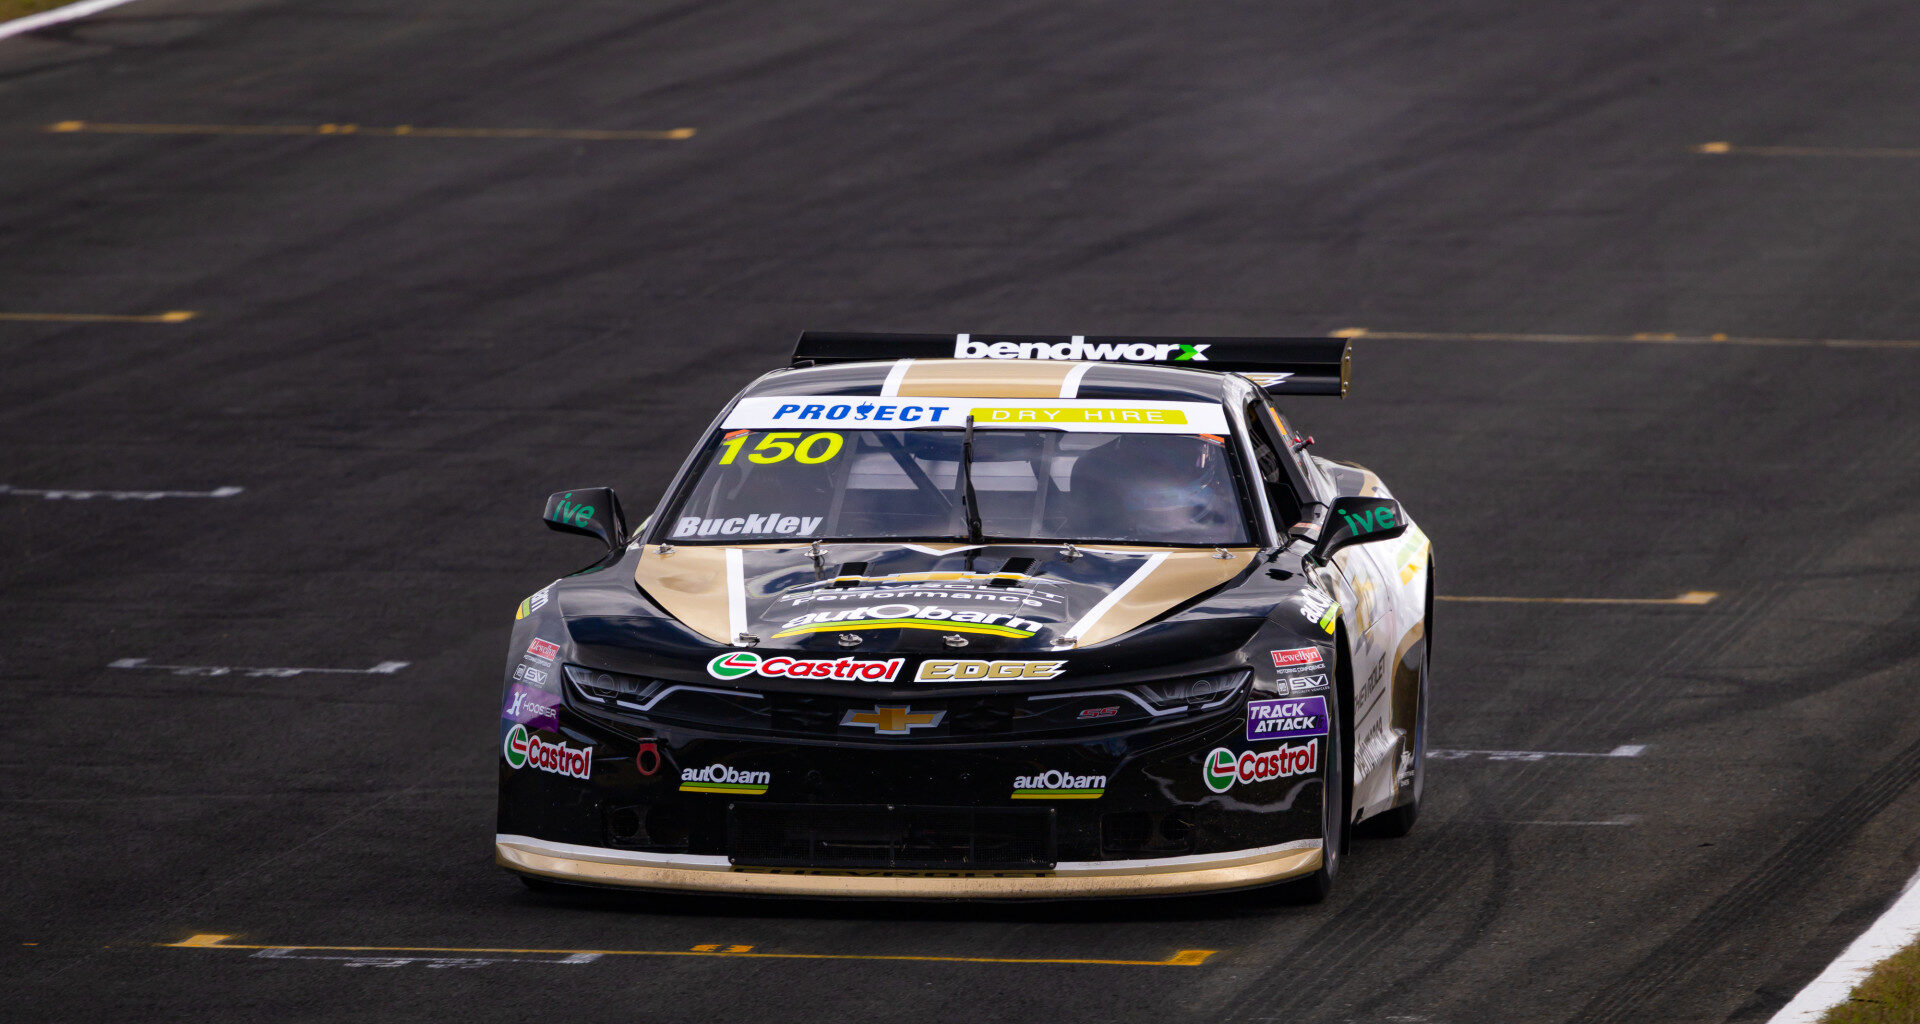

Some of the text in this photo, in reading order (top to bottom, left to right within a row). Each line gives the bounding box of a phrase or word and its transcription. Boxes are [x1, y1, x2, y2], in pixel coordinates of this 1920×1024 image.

[954, 333, 1211, 361] bendworx
[992, 409, 1165, 422] DRY HIRE
[718, 432, 844, 465] 150
[552, 492, 595, 528] ive
[1337, 506, 1395, 536] ive
[672, 513, 824, 537] Buckley
[792, 590, 1044, 607] Performance
[760, 656, 901, 681] Castrol
[1274, 650, 1318, 664] Llewellyn
[918, 659, 1062, 681] EDGE
[523, 701, 557, 719] HOOSIER
[1250, 702, 1305, 720] TRACK
[1254, 715, 1316, 733] ATTACK
[528, 738, 590, 778] Castrol
[1238, 742, 1316, 781] Castrol
